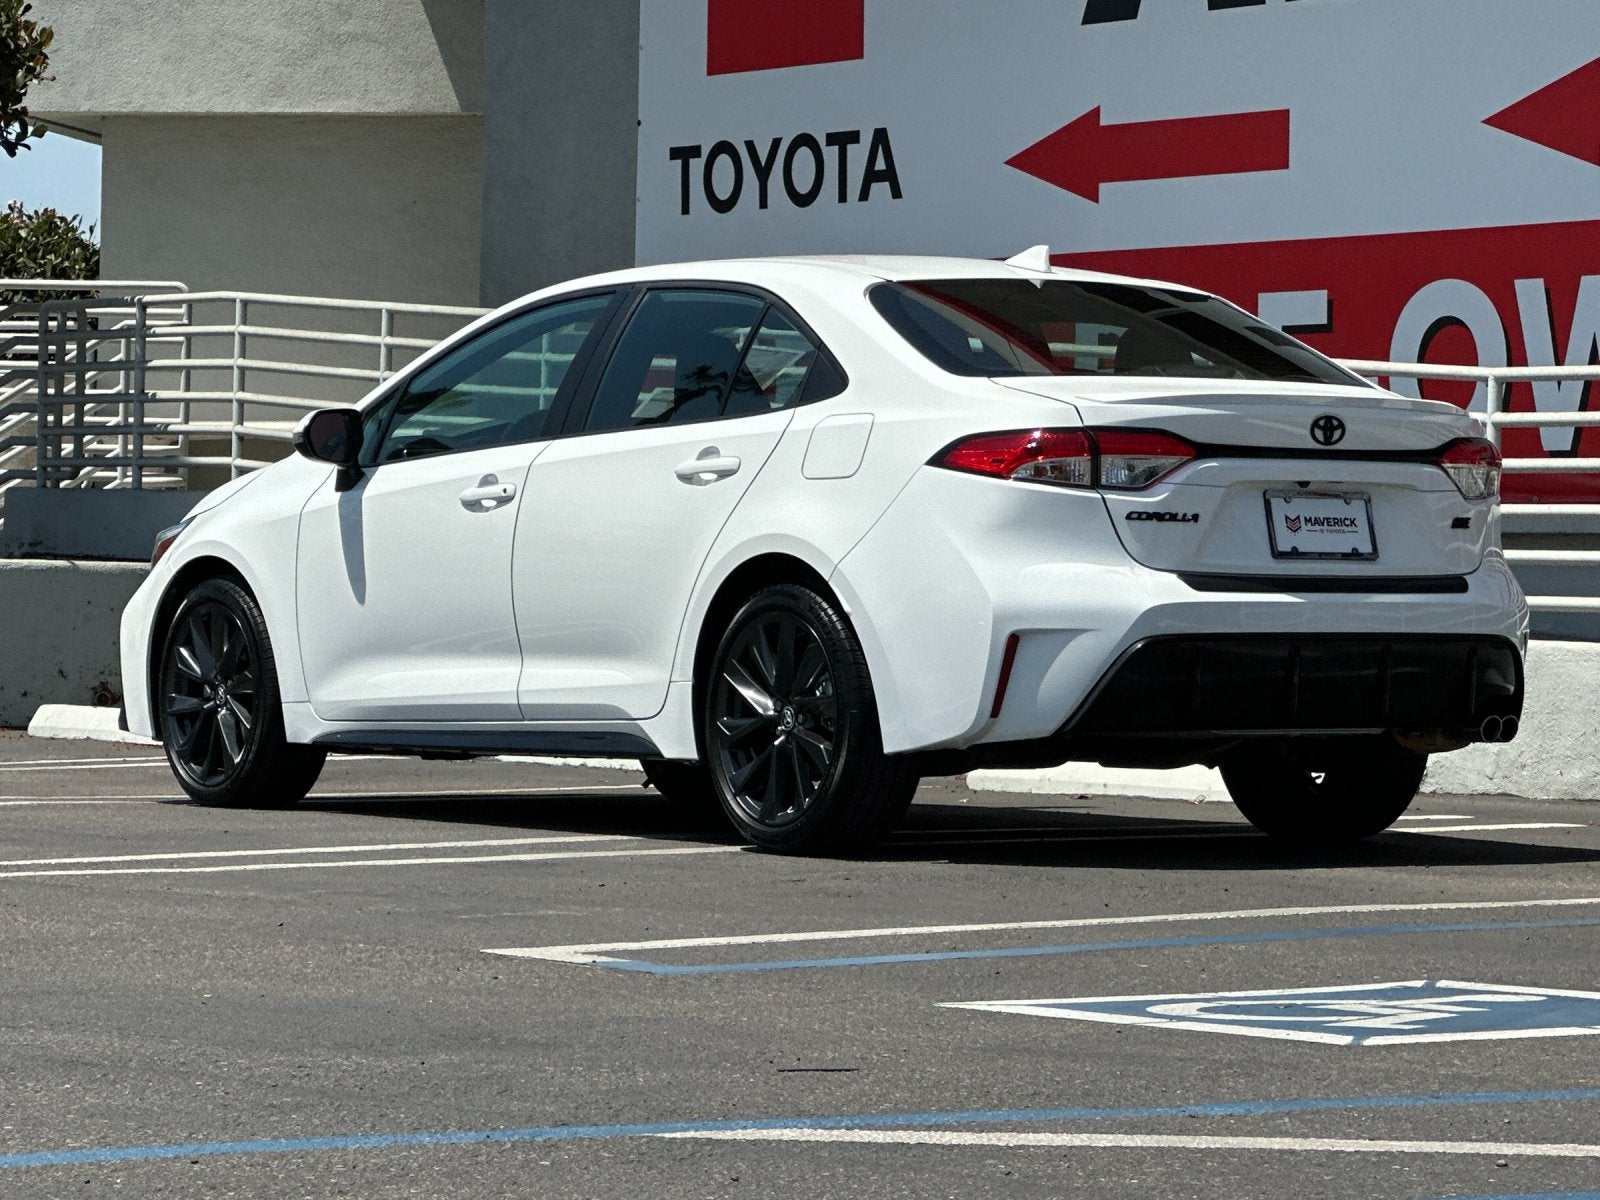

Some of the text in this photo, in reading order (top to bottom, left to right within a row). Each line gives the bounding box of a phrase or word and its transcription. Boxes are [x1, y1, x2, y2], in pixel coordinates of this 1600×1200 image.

[668, 127, 904, 216] TOYOTA
[1125, 510, 1200, 523] COROLLA
[1303, 516, 1359, 528] MAVERICK
